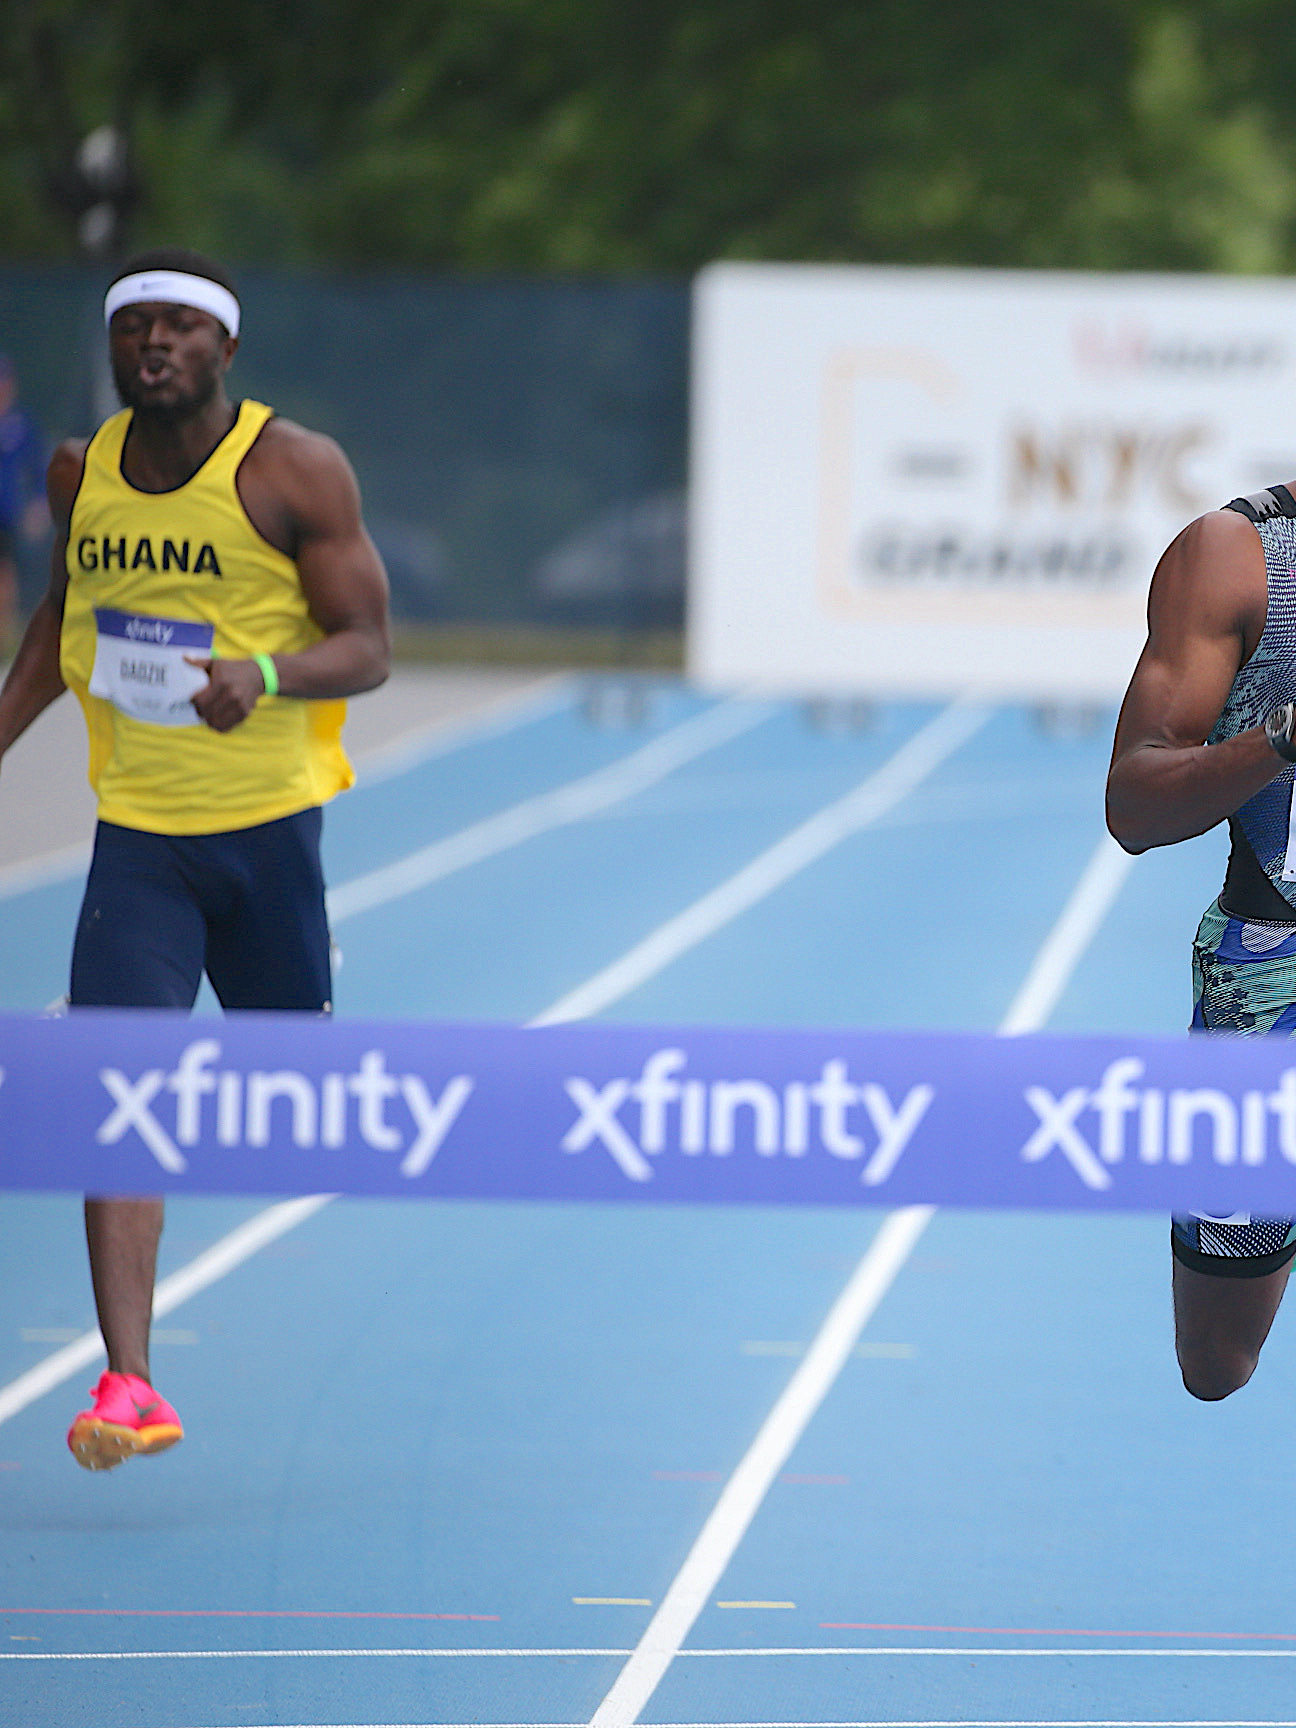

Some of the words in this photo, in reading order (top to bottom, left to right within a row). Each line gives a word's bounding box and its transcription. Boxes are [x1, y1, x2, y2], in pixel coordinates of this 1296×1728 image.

[1004, 410, 1214, 510] NYC
[77, 535, 223, 578] GHANA
[97, 1038, 475, 1179] xfinity
[560, 1046, 936, 1188] xfinity
